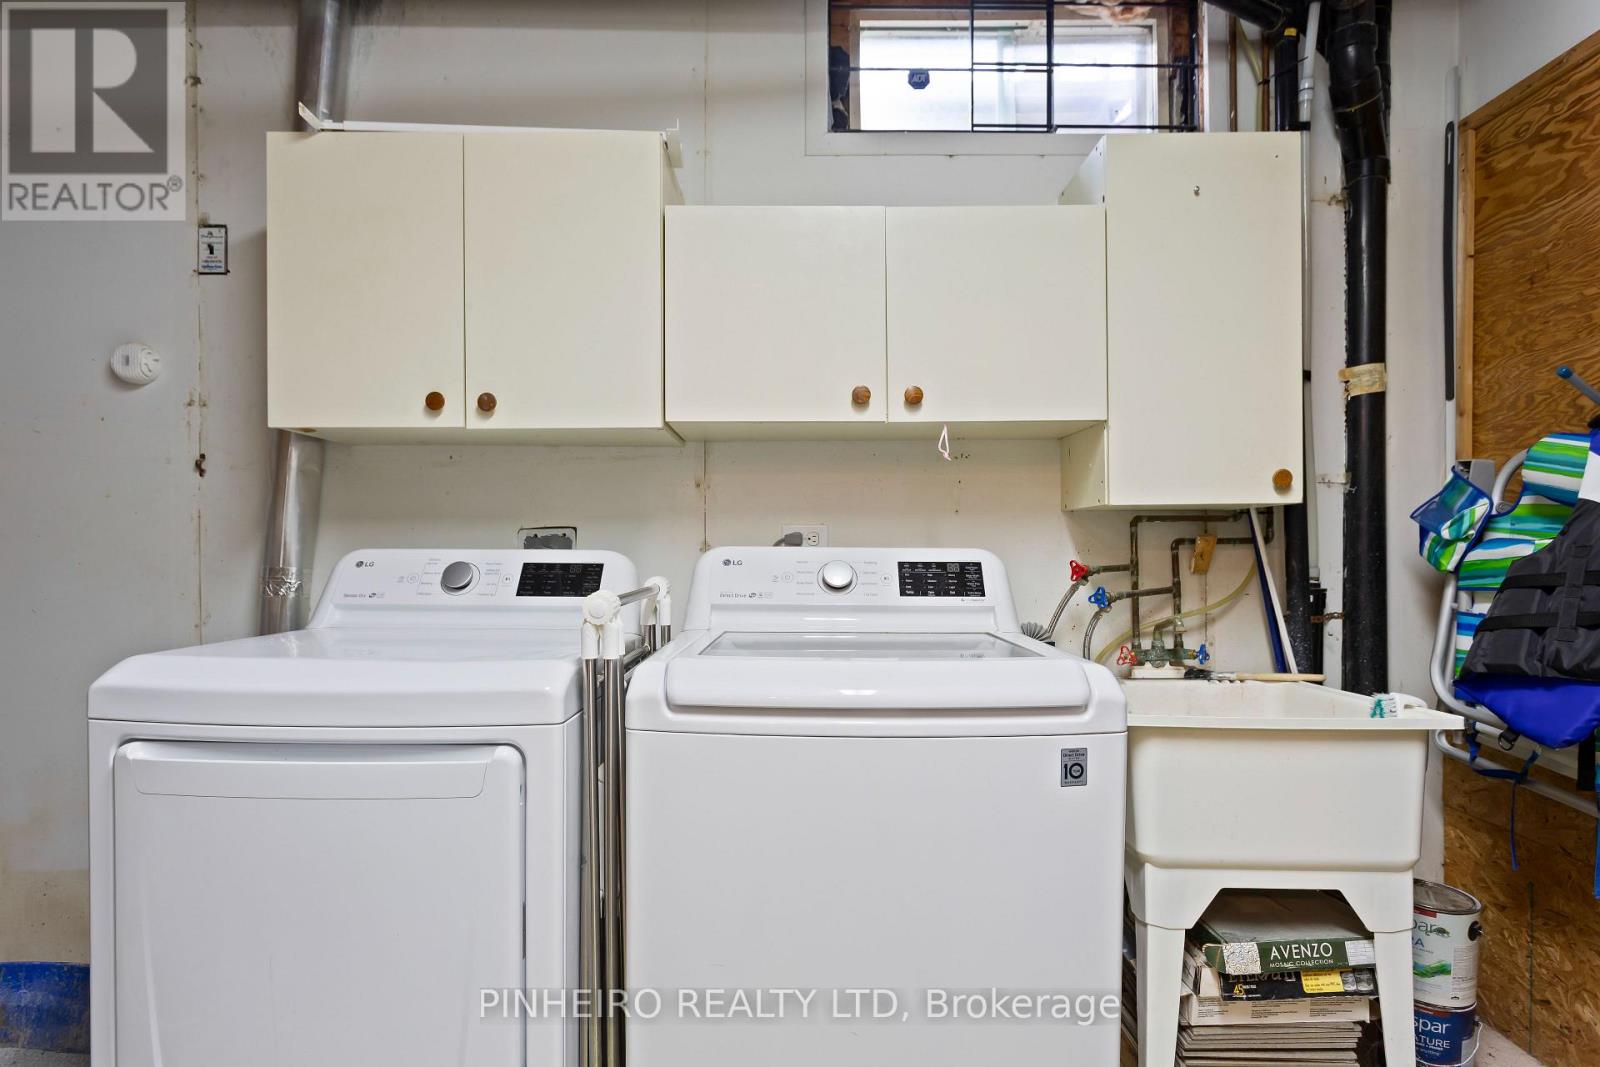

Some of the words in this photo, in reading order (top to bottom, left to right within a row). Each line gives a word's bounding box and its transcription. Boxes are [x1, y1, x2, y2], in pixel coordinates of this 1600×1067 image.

[1064, 762, 1084, 780] 10
[1270, 942, 1333, 960] AVENZO
[1269, 961, 1294, 969] MOSAIC
[1295, 959, 1334, 967] COLLECTION
